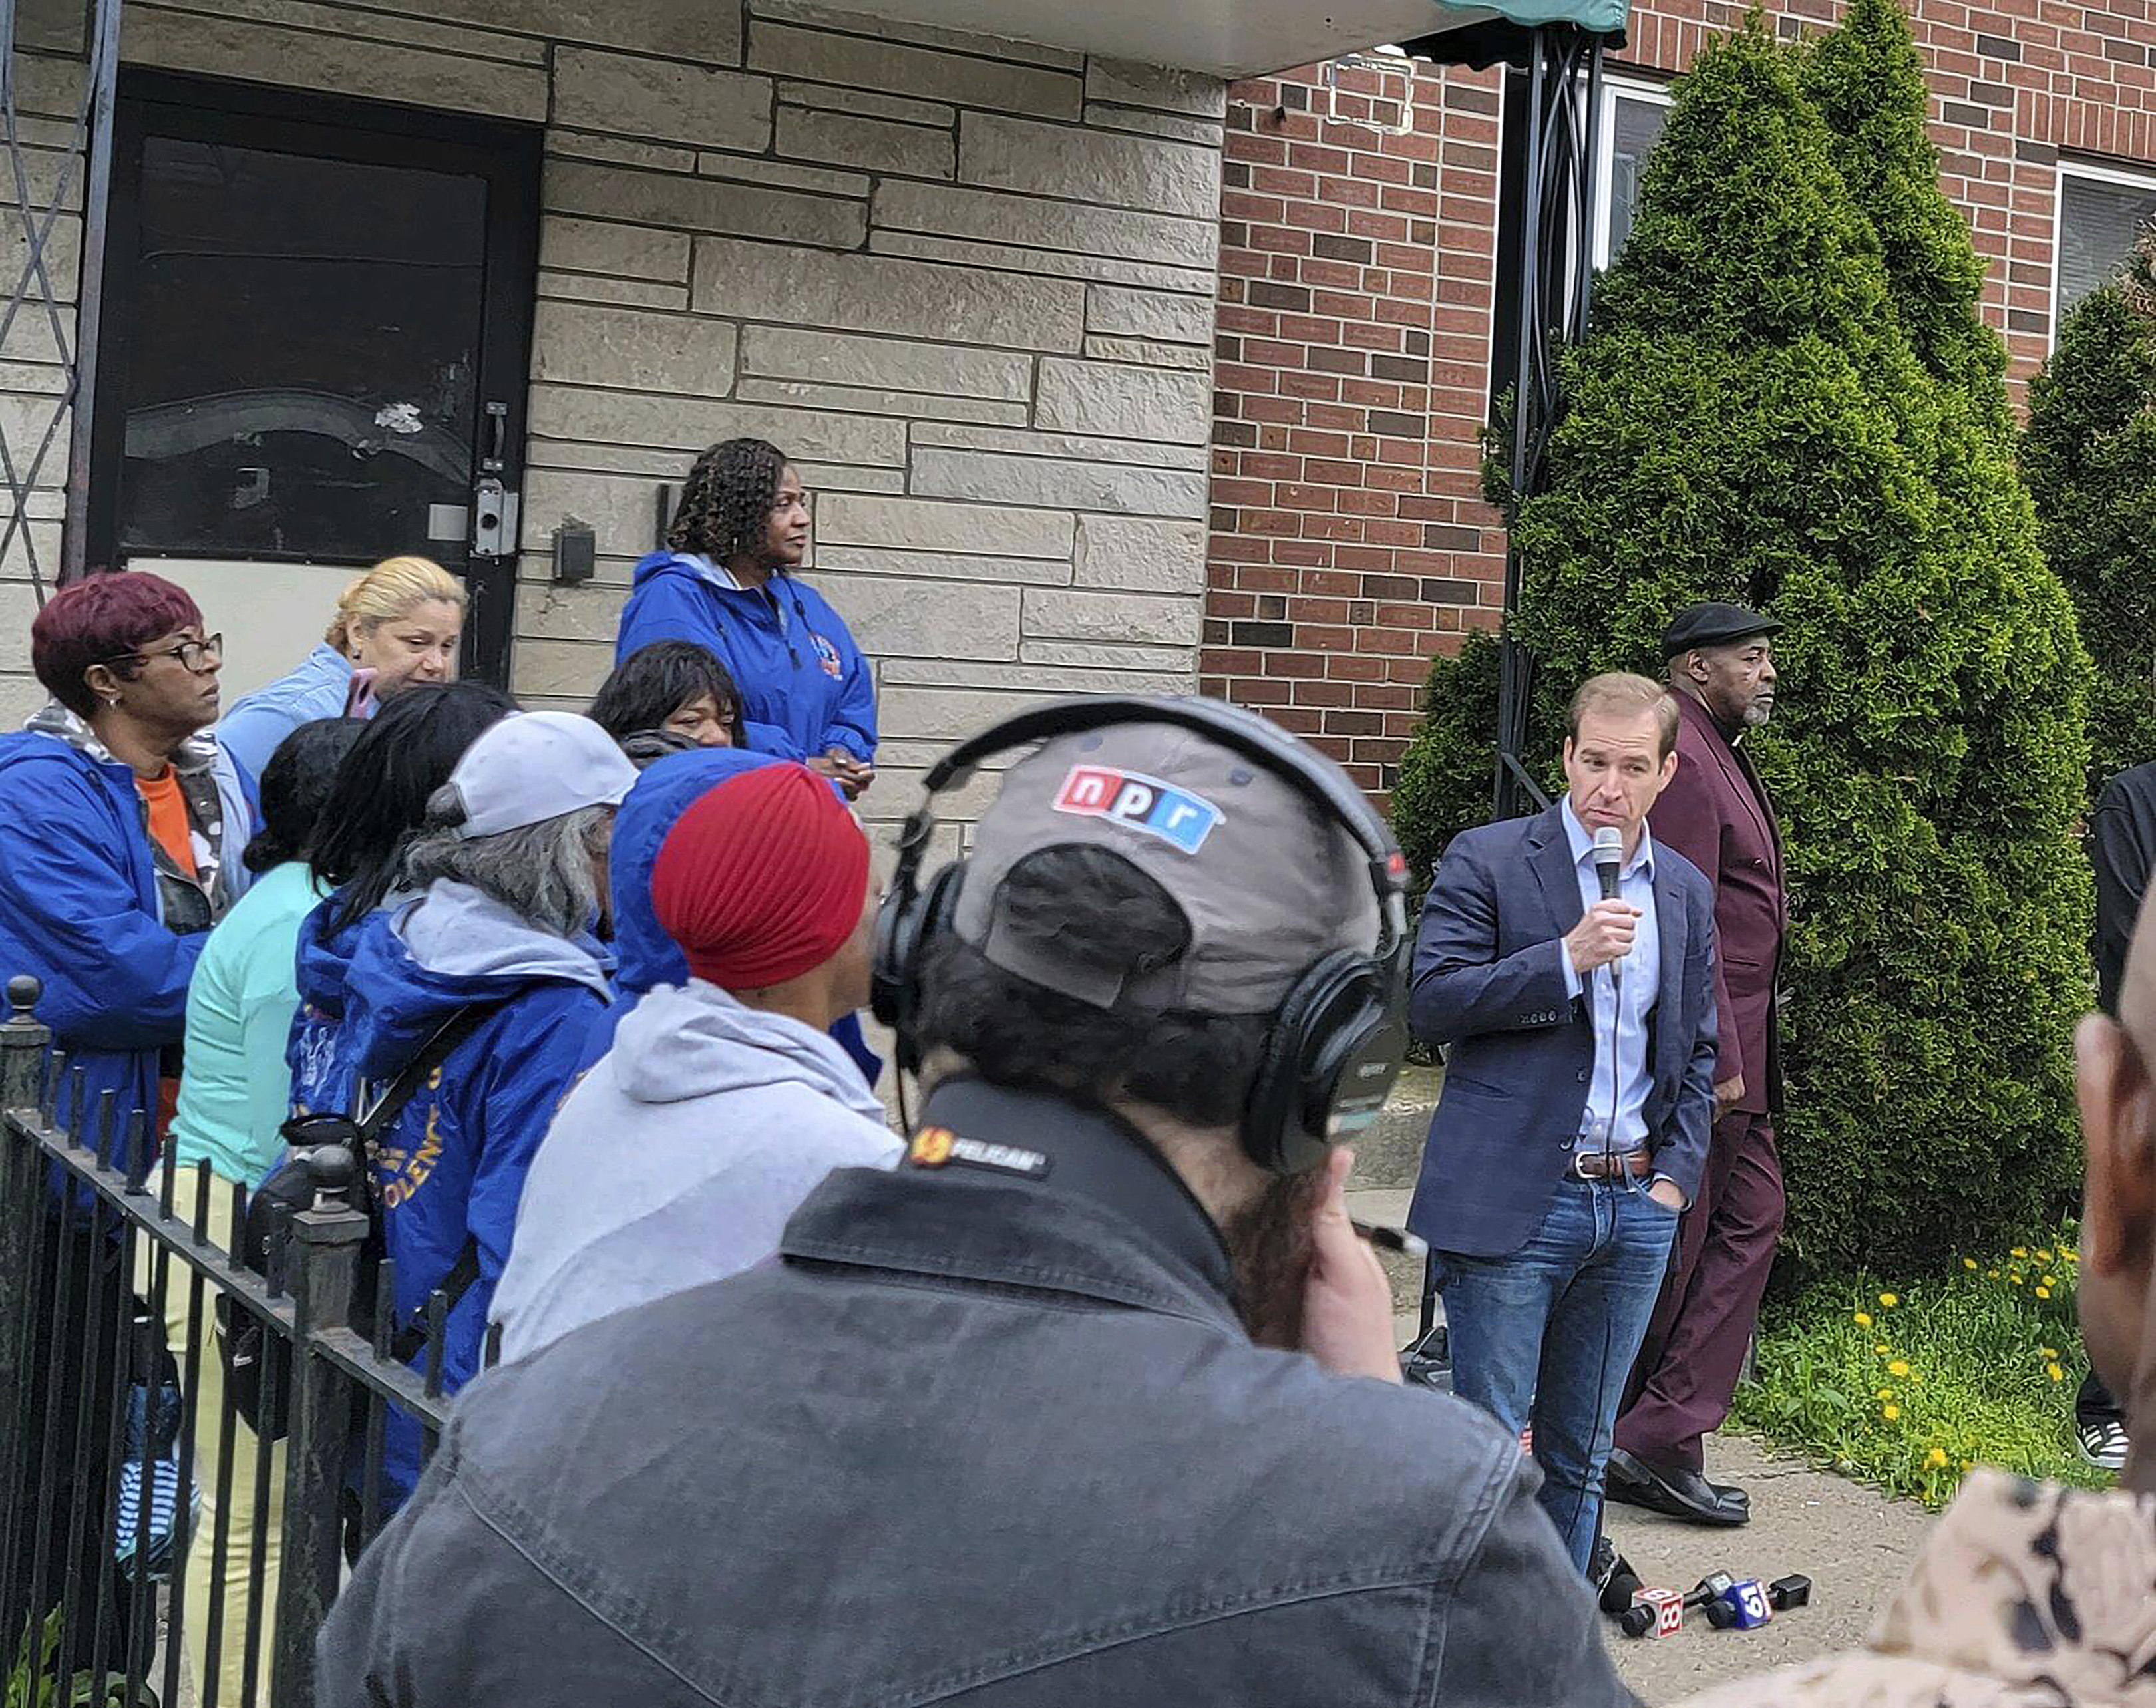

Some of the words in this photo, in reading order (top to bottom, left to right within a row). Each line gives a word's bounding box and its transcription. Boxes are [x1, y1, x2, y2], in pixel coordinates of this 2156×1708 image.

[1070, 775, 1200, 830] npr
[1662, 1604, 1680, 1629] 8
[1741, 1586, 1764, 1619] 61
